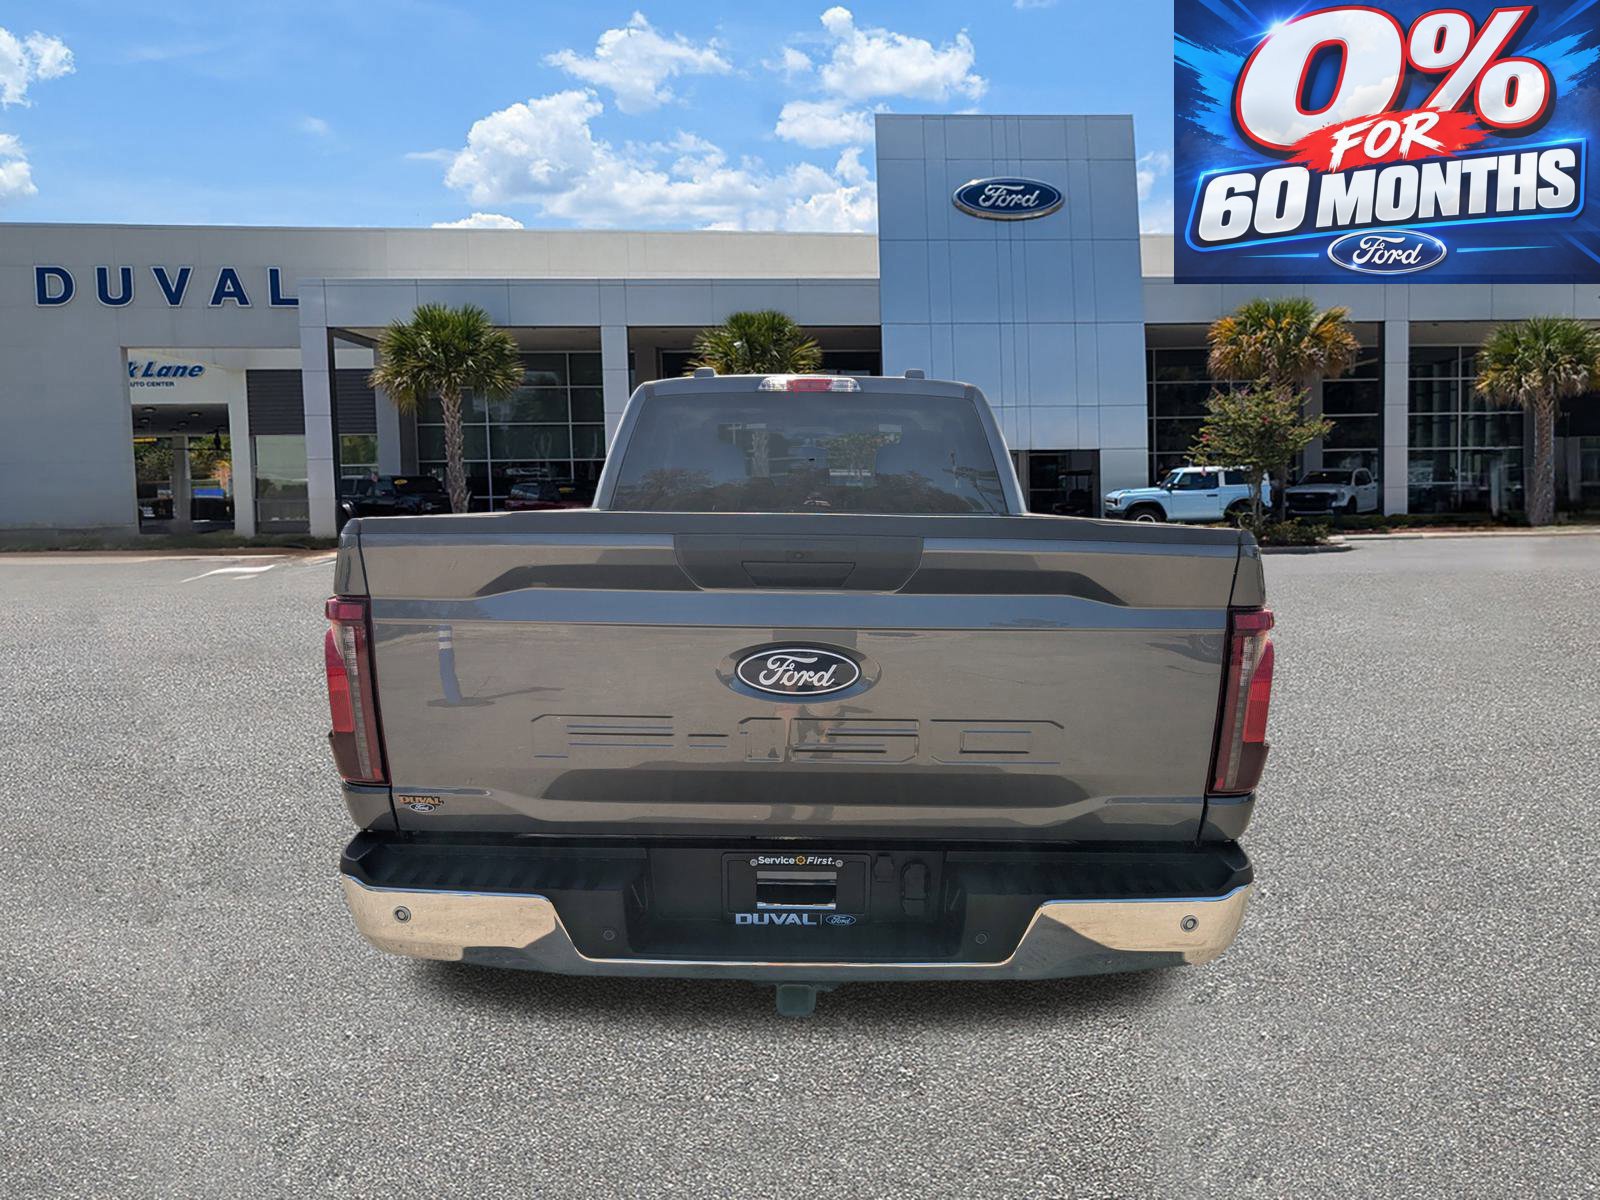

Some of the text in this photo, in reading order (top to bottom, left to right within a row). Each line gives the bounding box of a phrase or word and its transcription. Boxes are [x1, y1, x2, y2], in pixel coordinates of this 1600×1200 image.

[978, 184, 1040, 207] Ford
[34, 265, 299, 307] DUVAL
[141, 361, 205, 378] Lane
[759, 654, 837, 688] Ford
[758, 856, 835, 865] Service First.
[735, 913, 817, 925] DUVAL
